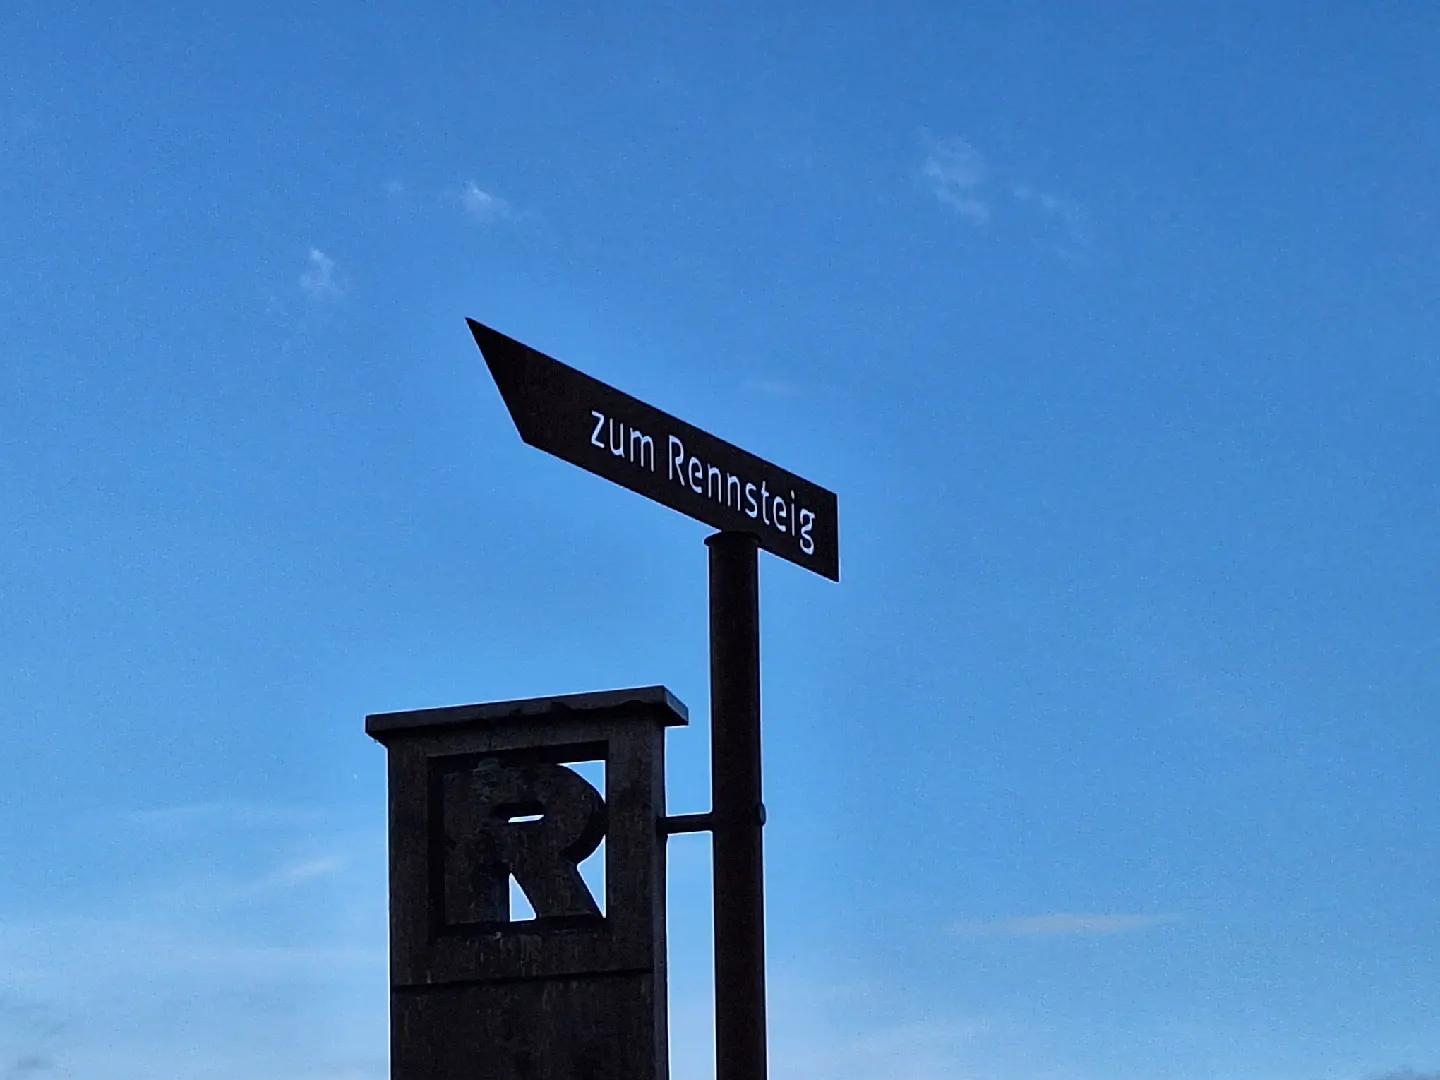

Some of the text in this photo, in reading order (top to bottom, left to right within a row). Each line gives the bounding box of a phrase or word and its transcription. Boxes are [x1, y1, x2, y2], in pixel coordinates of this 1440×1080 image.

[591, 410, 816, 555] zum Rennsteig
[444, 763, 606, 925] R
